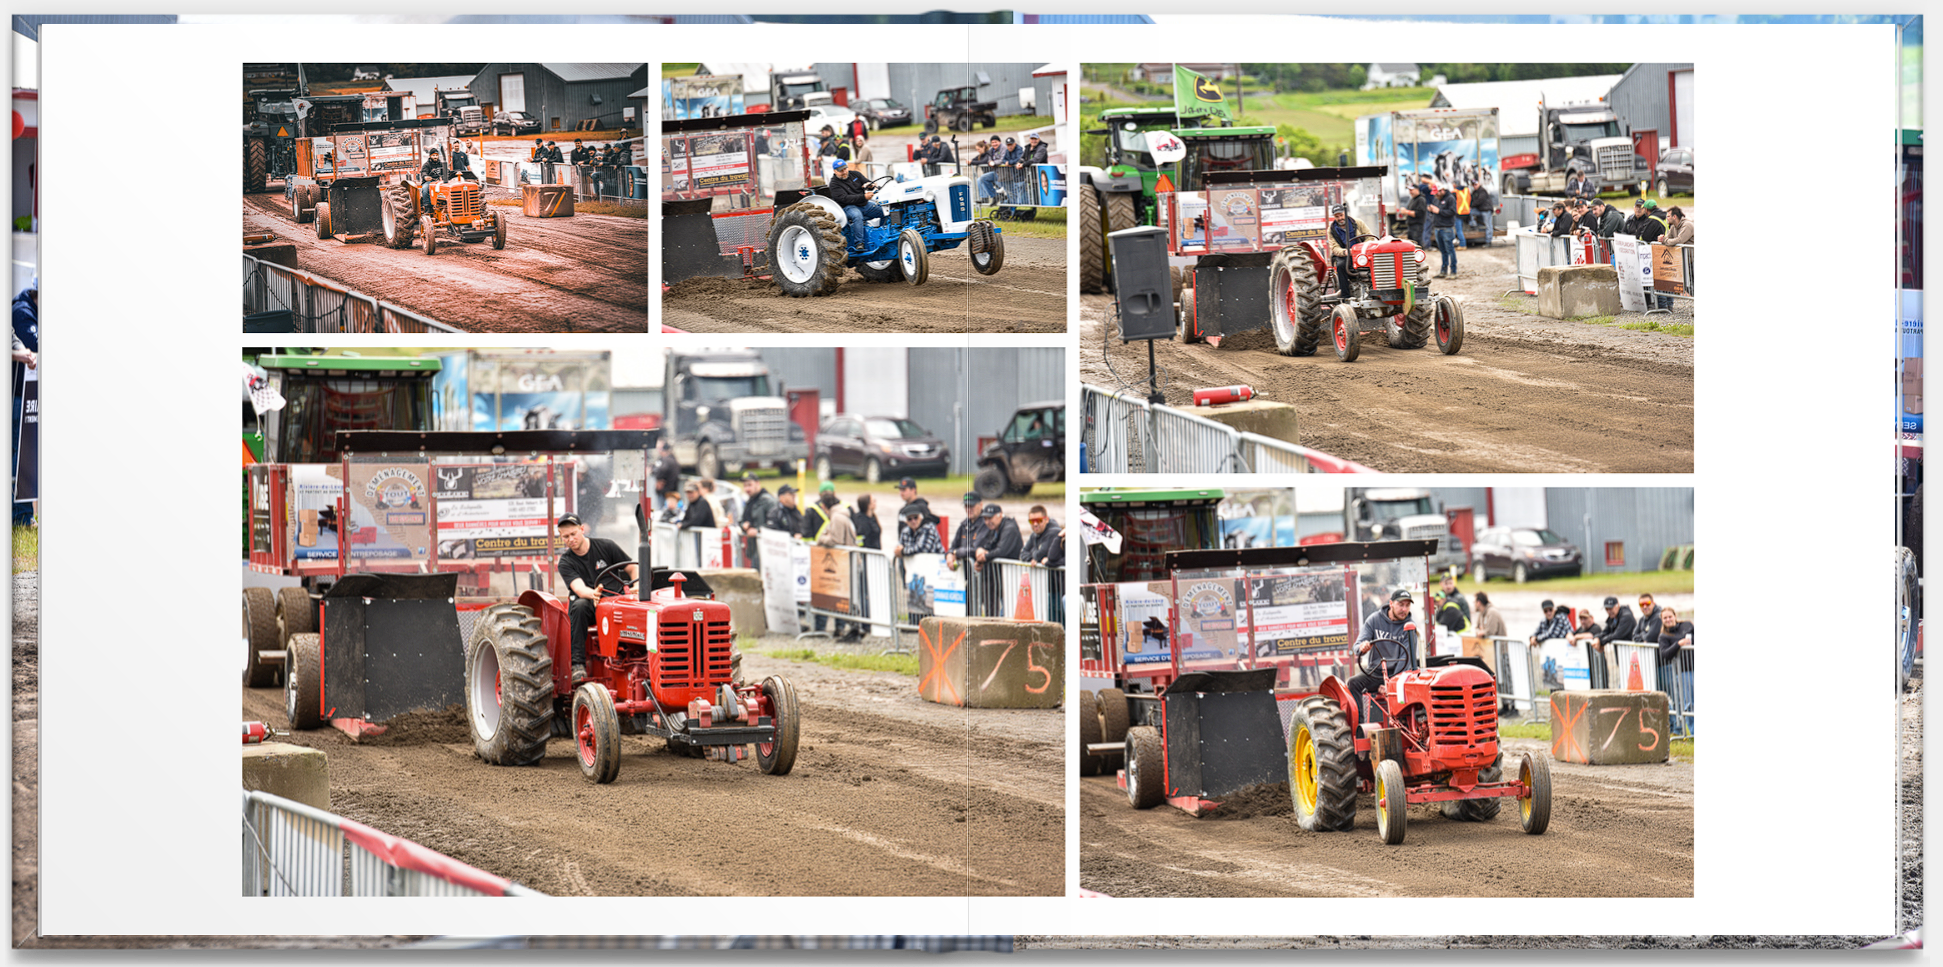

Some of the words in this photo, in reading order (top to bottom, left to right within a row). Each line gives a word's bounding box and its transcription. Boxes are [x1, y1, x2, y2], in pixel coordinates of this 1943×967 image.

[697, 87, 720, 98] GEA
[1430, 126, 1464, 141] GEA
[958, 191, 966, 212] FORD
[518, 373, 564, 392] GEA
[365, 467, 426, 497] DÉMÉNAGEMENT
[476, 538, 512, 548] Centre
[514, 537, 528, 546] du
[1182, 582, 1234, 608] DÉMÉNAGEMENT
[1277, 638, 1307, 648] Centre
[1311, 636, 1322, 645] du
[1323, 634, 1348, 643] trava
[979, 639, 1055, 694] 75
[1134, 655, 1160, 663] SERVICE
[1599, 706, 1661, 752] 75
